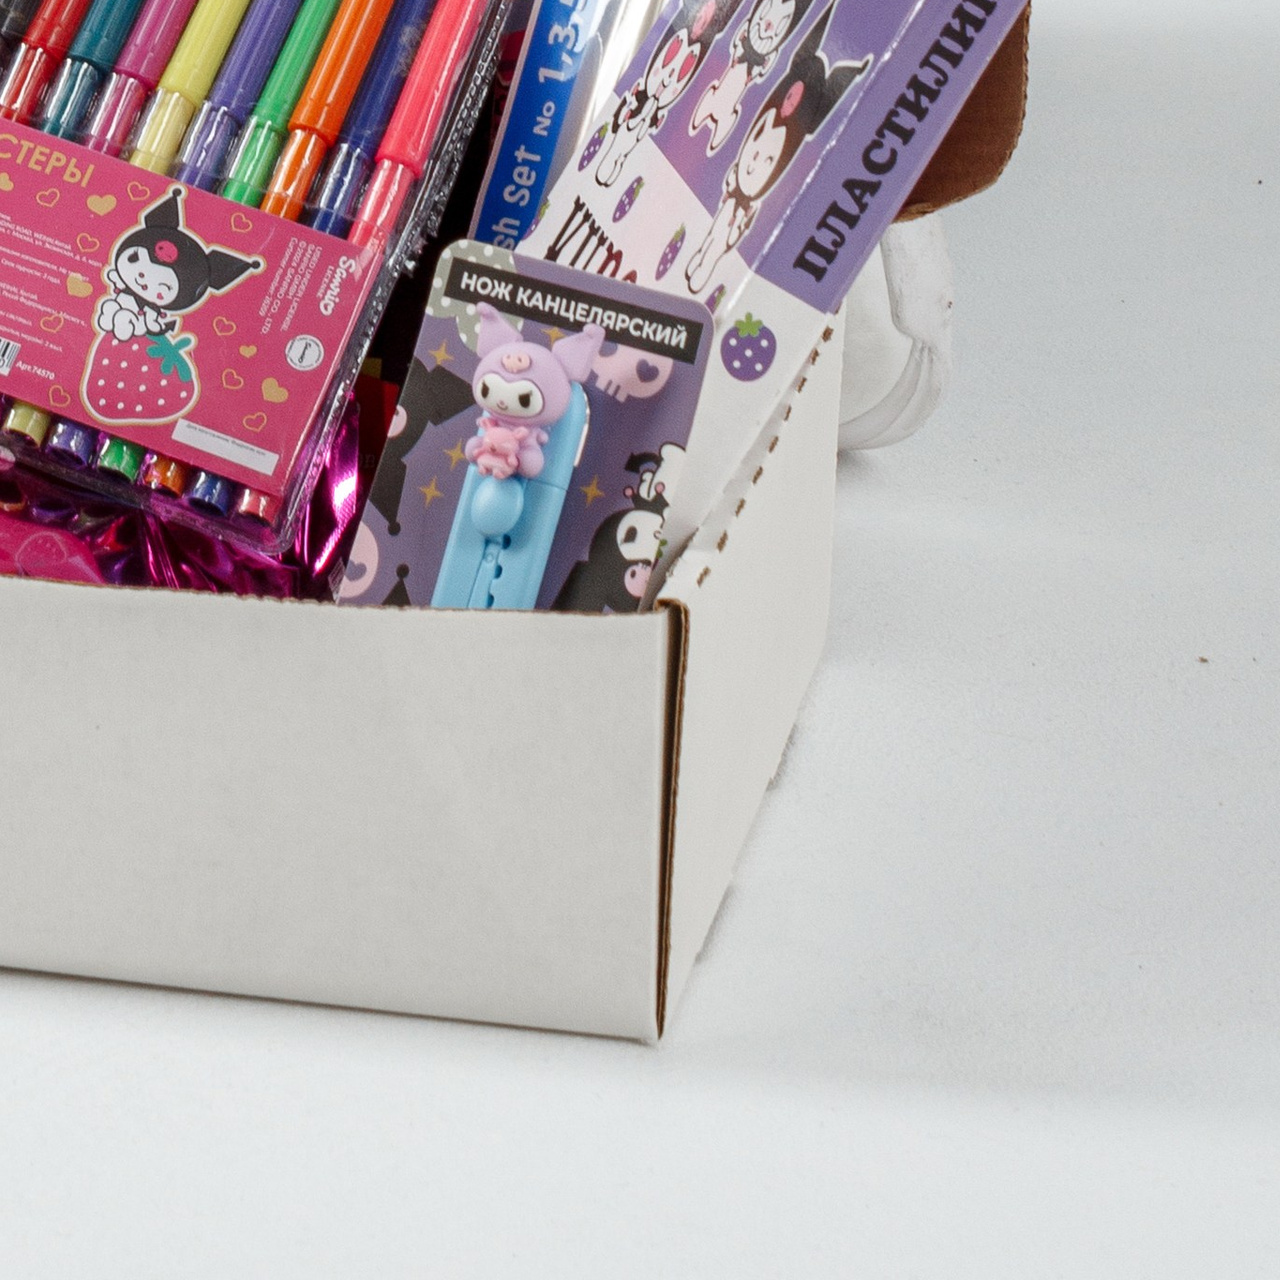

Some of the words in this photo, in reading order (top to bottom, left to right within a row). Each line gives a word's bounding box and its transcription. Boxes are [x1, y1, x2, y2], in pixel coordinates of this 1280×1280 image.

[532, 101, 558, 139] No
[503, 144, 543, 207] Set
[491, 217, 521, 251] sh
[307, 245, 322, 269] USED
[275, 265, 295, 301] SANRIO
[294, 267, 313, 298] UNDER
[460, 271, 514, 306] НОЖ
[515, 286, 690, 350] КАНЦЕЛЯРСКИЙ
